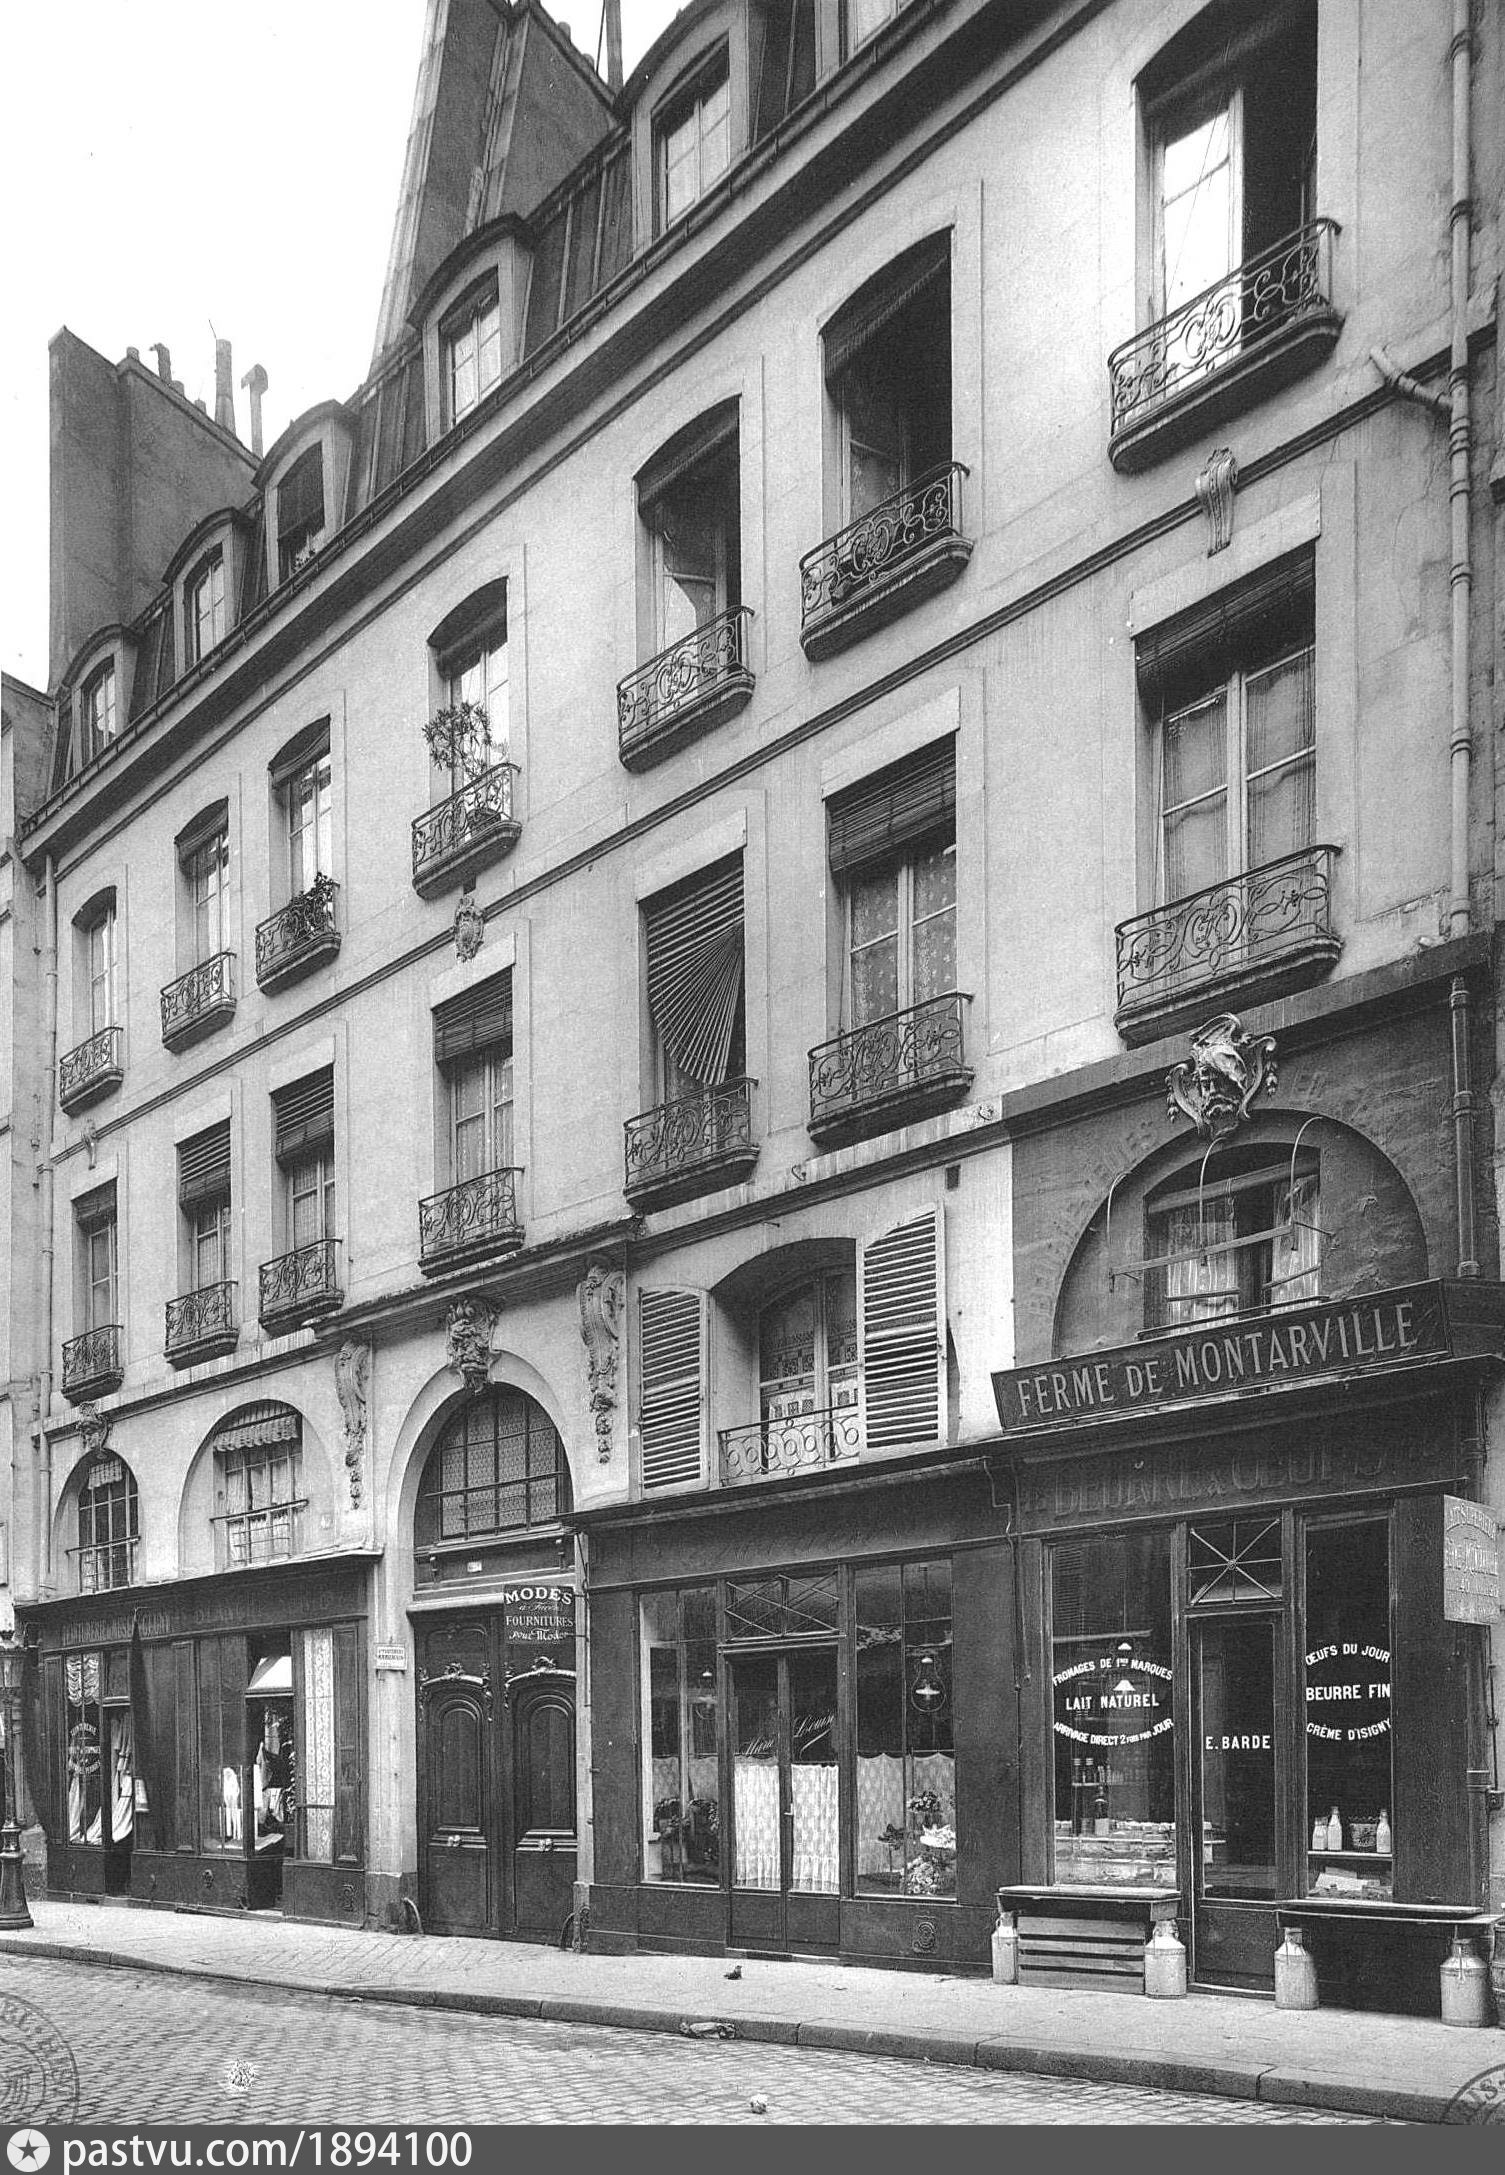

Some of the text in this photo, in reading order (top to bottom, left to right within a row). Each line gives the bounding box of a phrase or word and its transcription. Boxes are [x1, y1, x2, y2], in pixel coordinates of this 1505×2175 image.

[1017, 1301, 1419, 1417] FERME DE MONTARVILLE
[505, 1587, 573, 1604] MODES
[505, 1615, 573, 1628] FOURNITURES
[1343, 1643, 1358, 1655] DU
[1361, 1645, 1391, 1664] JOUR
[1052, 1660, 1096, 1687] FROMAGES
[1100, 1658, 1112, 1669] DE
[1130, 1659, 1173, 1681] MARQUES
[1306, 1683, 1391, 1700] BEURRE FIN
[1065, 1693, 1160, 1711] LAIT NATUREL
[1052, 1721, 1090, 1743] ARRIVAGE
[1090, 1734, 1119, 1746] DIRECT
[1119, 1734, 1126, 1745] 2
[1152, 1718, 1174, 1736] JOUR
[1347, 1717, 1392, 1741] D'ISIGNY
[1222, 1734, 1271, 1750] BARDE
